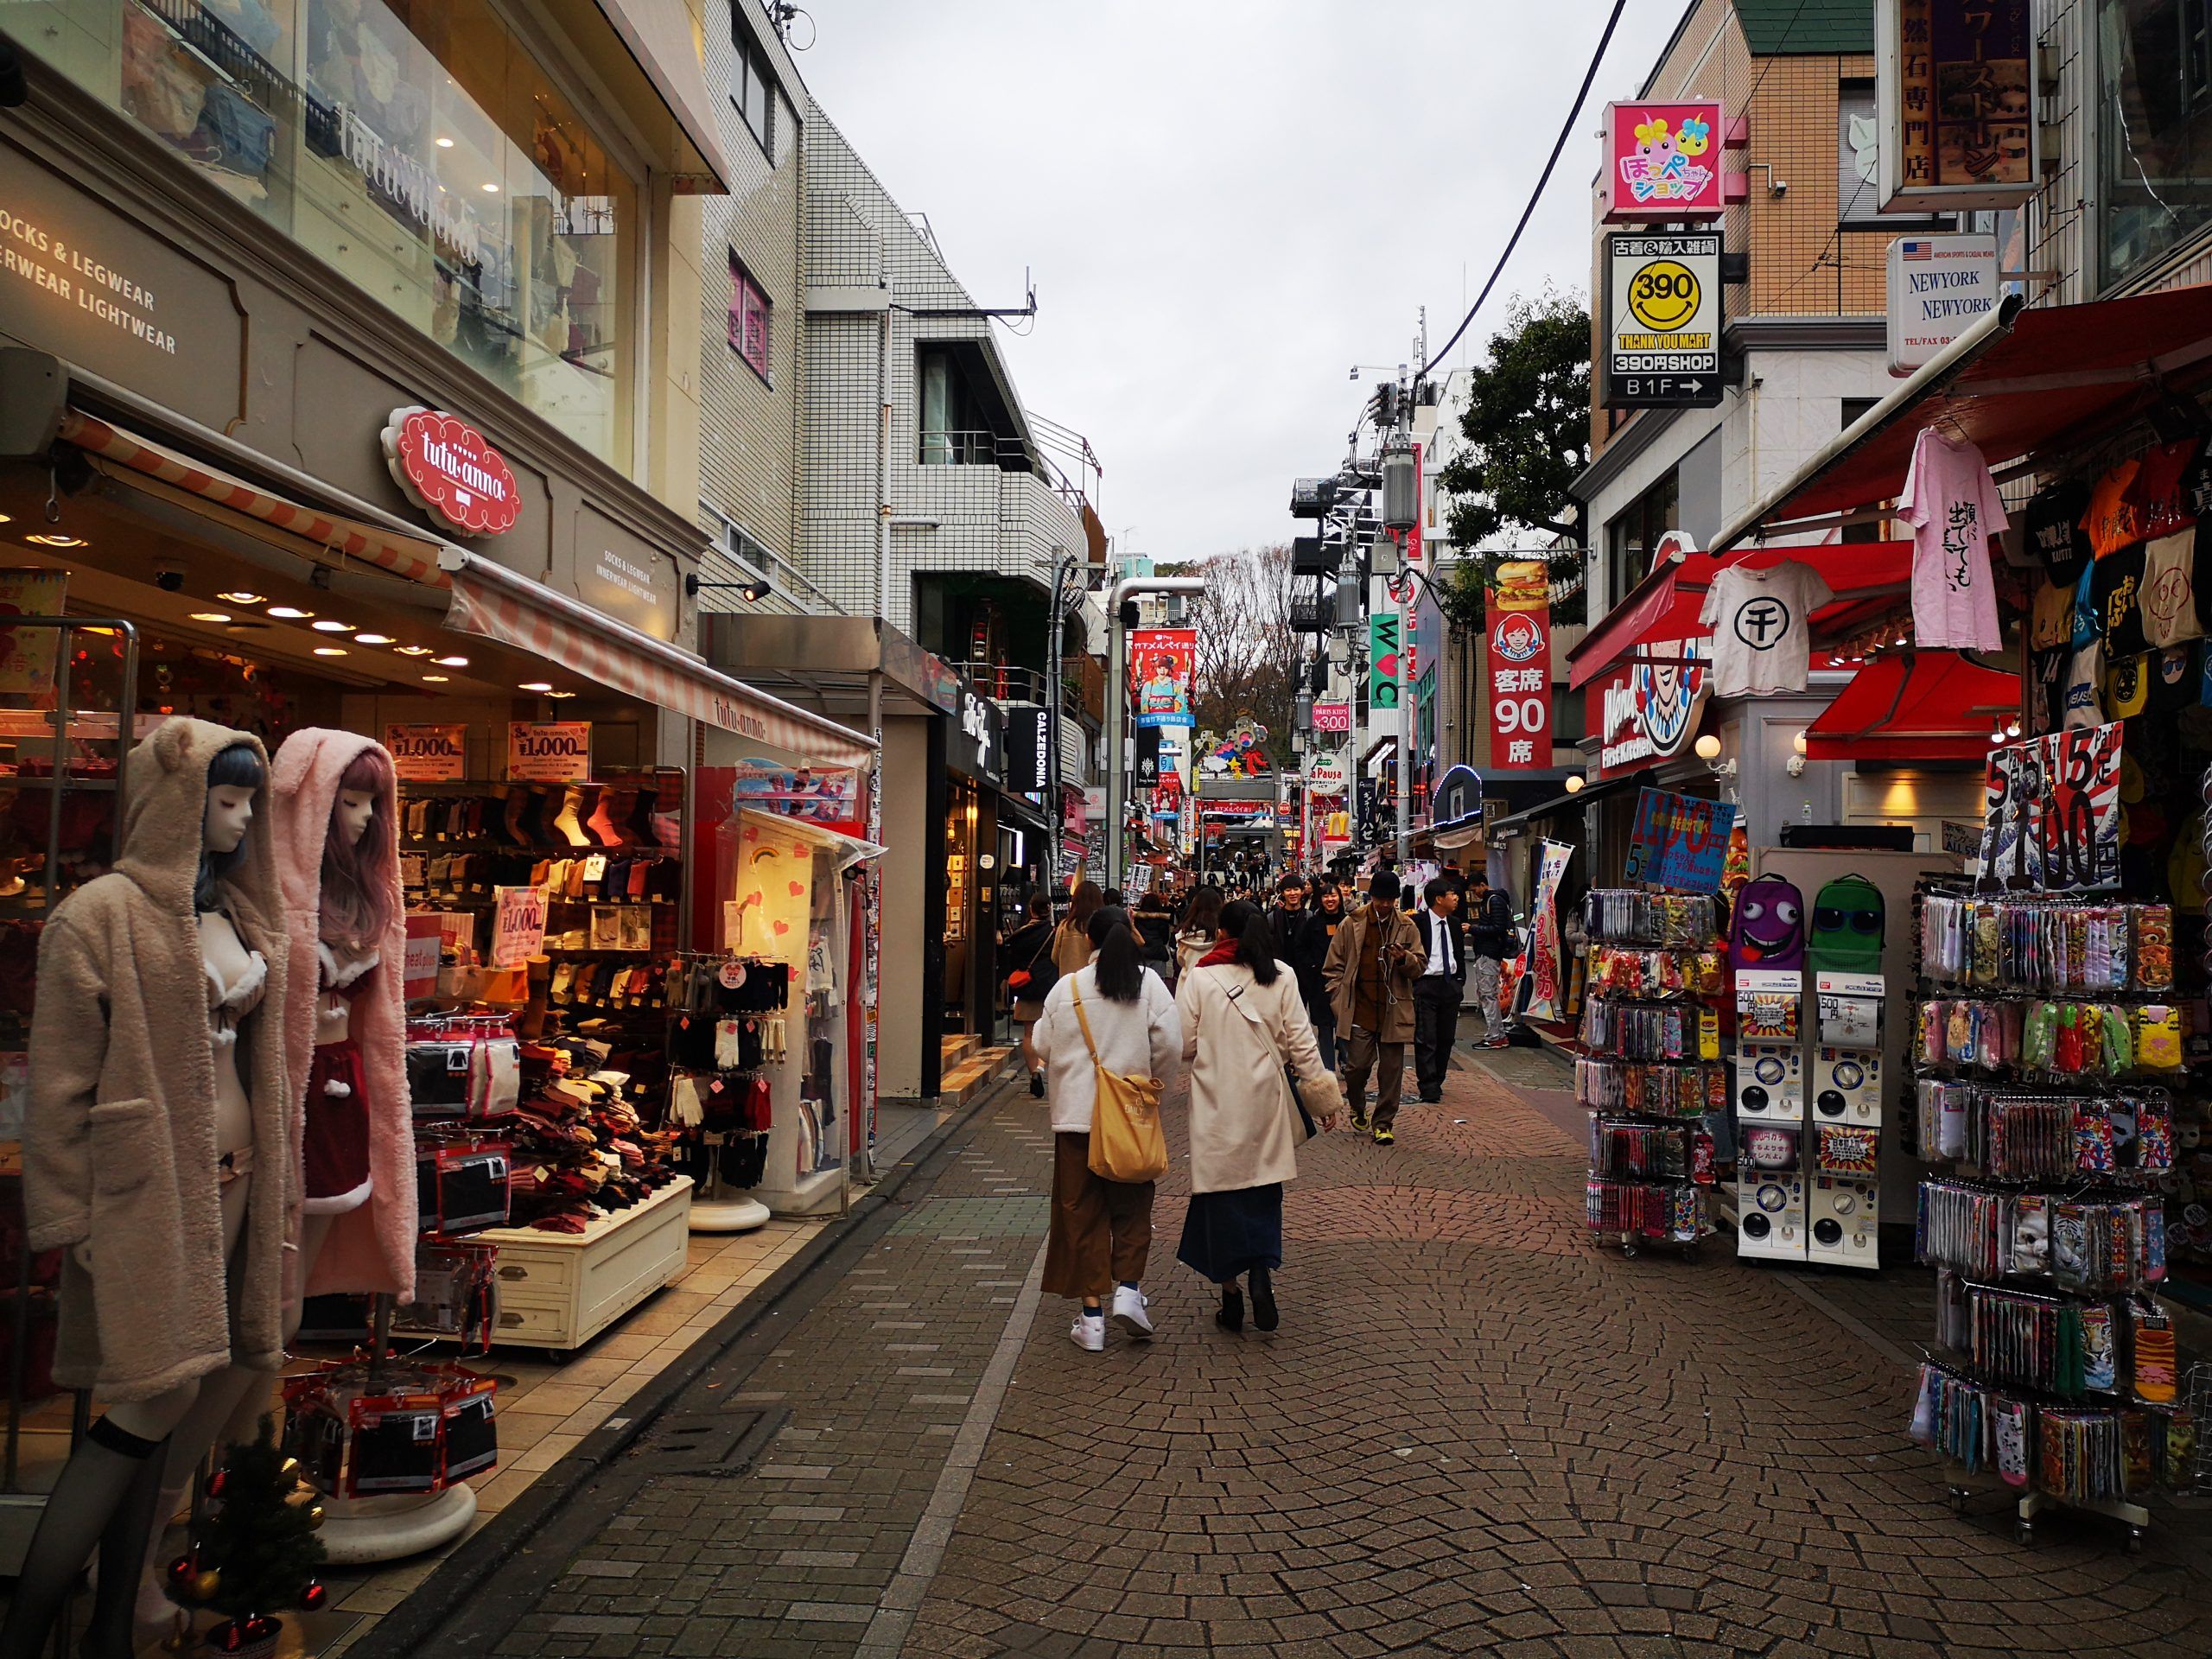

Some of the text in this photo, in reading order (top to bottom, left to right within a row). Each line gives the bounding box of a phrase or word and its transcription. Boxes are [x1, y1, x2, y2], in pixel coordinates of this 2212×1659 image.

[1633, 180, 1705, 199] ショップ
[1615, 240, 1715, 256] 古着&輸入雑貨
[54, 241, 67, 264] &
[73, 251, 156, 312] LEGWEAR
[1637, 273, 1694, 300] 390
[1909, 270, 1980, 295] NEWYORK
[0, 245, 175, 354] RWEAR LIGHTWEAR
[1922, 297, 1993, 321] NEWYORK
[1618, 334, 1656, 350] THANK
[1904, 337, 1938, 346] TEL/FAX
[1615, 355, 1714, 372] 390円SHOP
[604, 550, 651, 585] SOCKS & LEGWEAR
[596, 563, 657, 605] INNERWEAR LIGHTWEAR
[1494, 667, 1544, 693] 客席
[1495, 697, 1545, 734] 90
[1036, 711, 1047, 788] CALZEDONIA
[1507, 739, 1534, 764] 席
[1602, 736, 1652, 769] First Kitchen
[1317, 767, 1342, 780] Pausa
[1738, 991, 1755, 1003] 500
[1821, 998, 1839, 1010] 500
